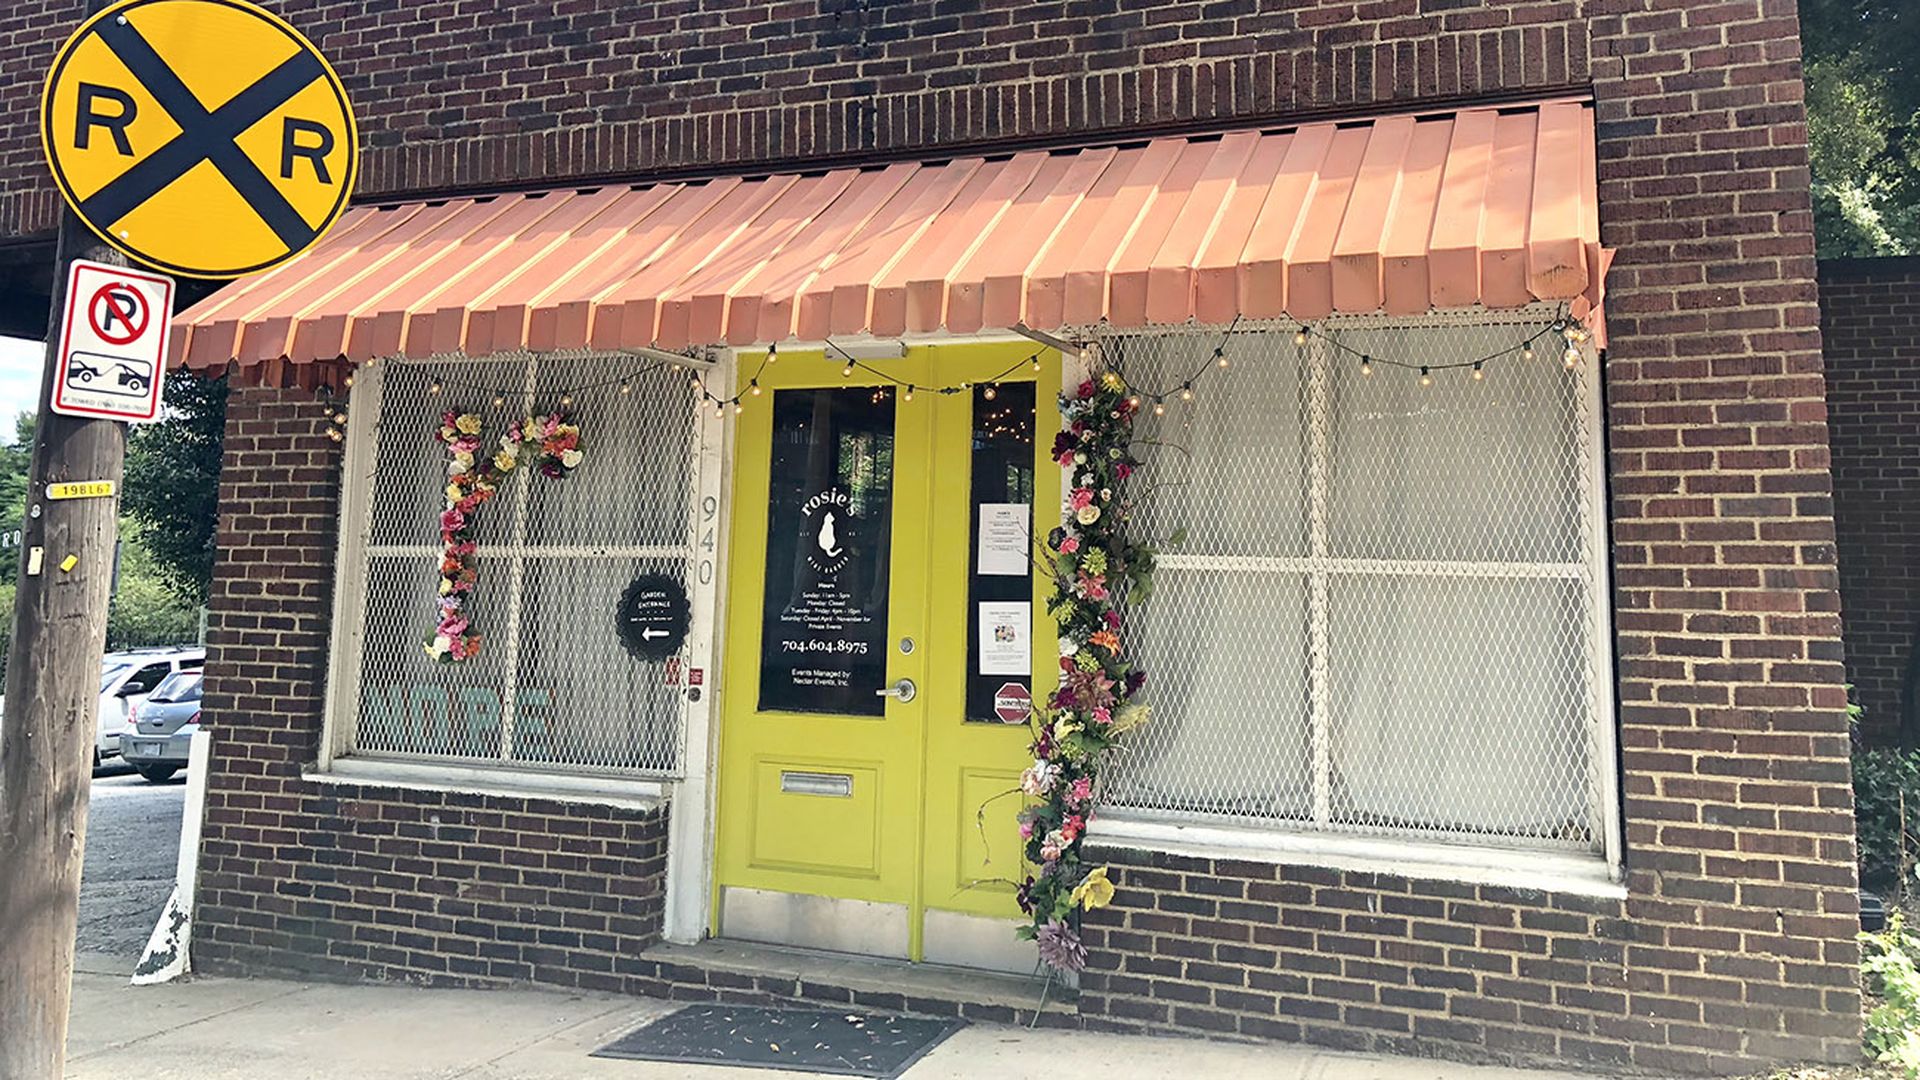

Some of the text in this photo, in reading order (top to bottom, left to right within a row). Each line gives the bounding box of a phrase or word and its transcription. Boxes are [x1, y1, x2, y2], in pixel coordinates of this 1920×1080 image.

[74, 81, 137, 157] R
[280, 116, 334, 185] R
[801, 487, 857, 516] rosie's
[700, 496, 717, 585] 940
[782, 639, 868, 655] 704.604.8975
[791, 668, 812, 676] Events
[813, 669, 841, 678] Managed
